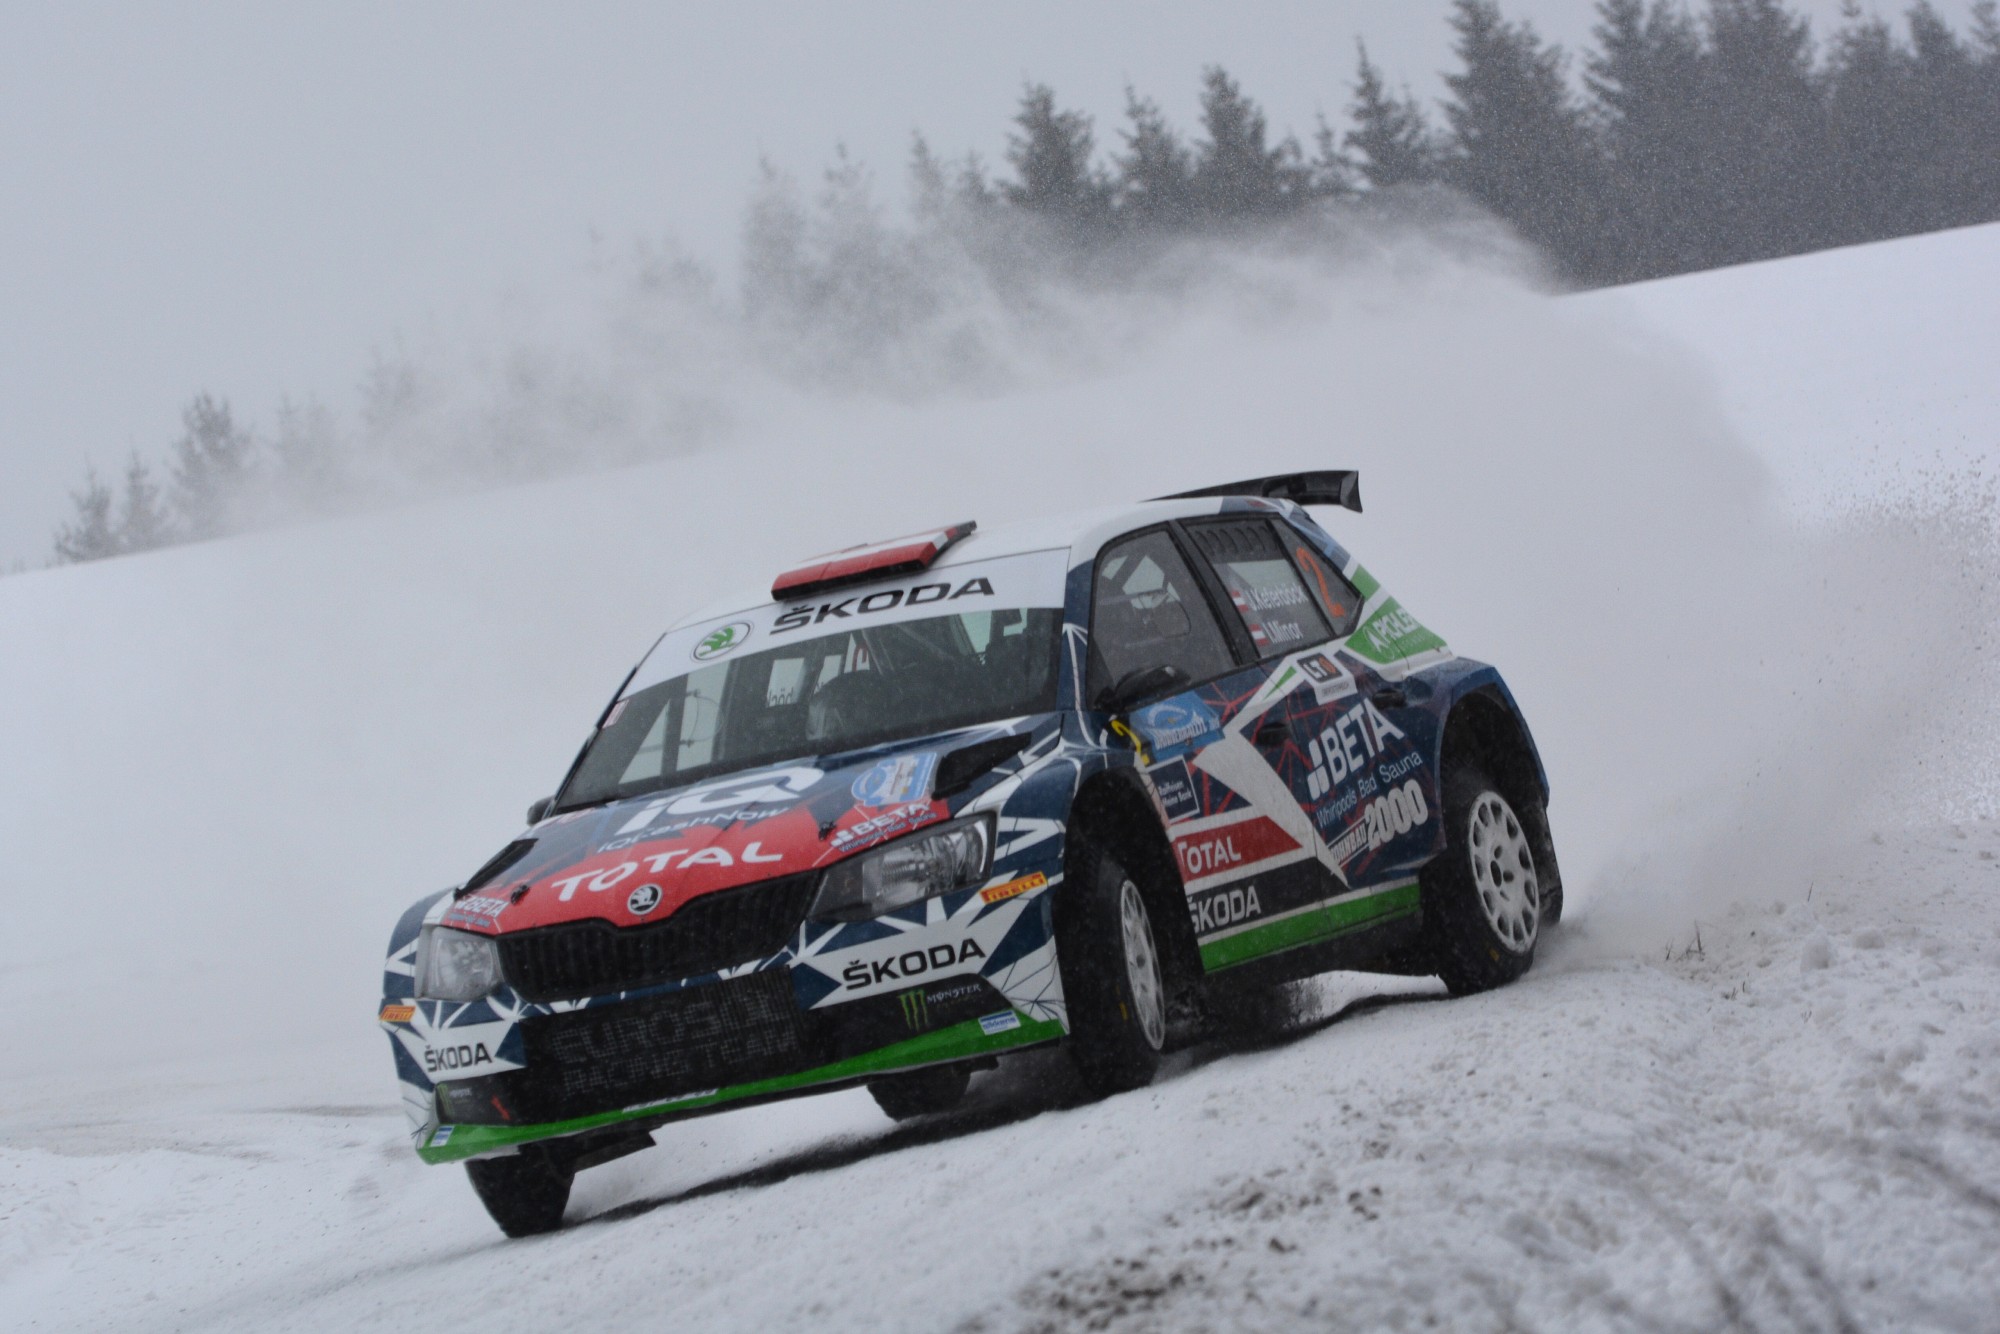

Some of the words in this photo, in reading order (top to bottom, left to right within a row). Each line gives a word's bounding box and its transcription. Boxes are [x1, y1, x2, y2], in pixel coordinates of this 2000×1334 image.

[769, 577, 995, 635] ŠKODA
[1296, 547, 1345, 618] 2
[1320, 698, 1405, 785] BETA
[851, 803, 930, 834] BETA
[1316, 789, 1357, 829] Whirlpools
[1358, 775, 1378, 798] Bad
[1379, 751, 1423, 783] Sauna
[1364, 779, 1428, 851] 2000
[551, 841, 783, 902] TOTAL
[1177, 836, 1241, 874] TOTAL
[842, 938, 986, 990] ŠKODA
[927, 983, 982, 1003] MONSTER
[424, 1042, 493, 1073] ŠKODA
